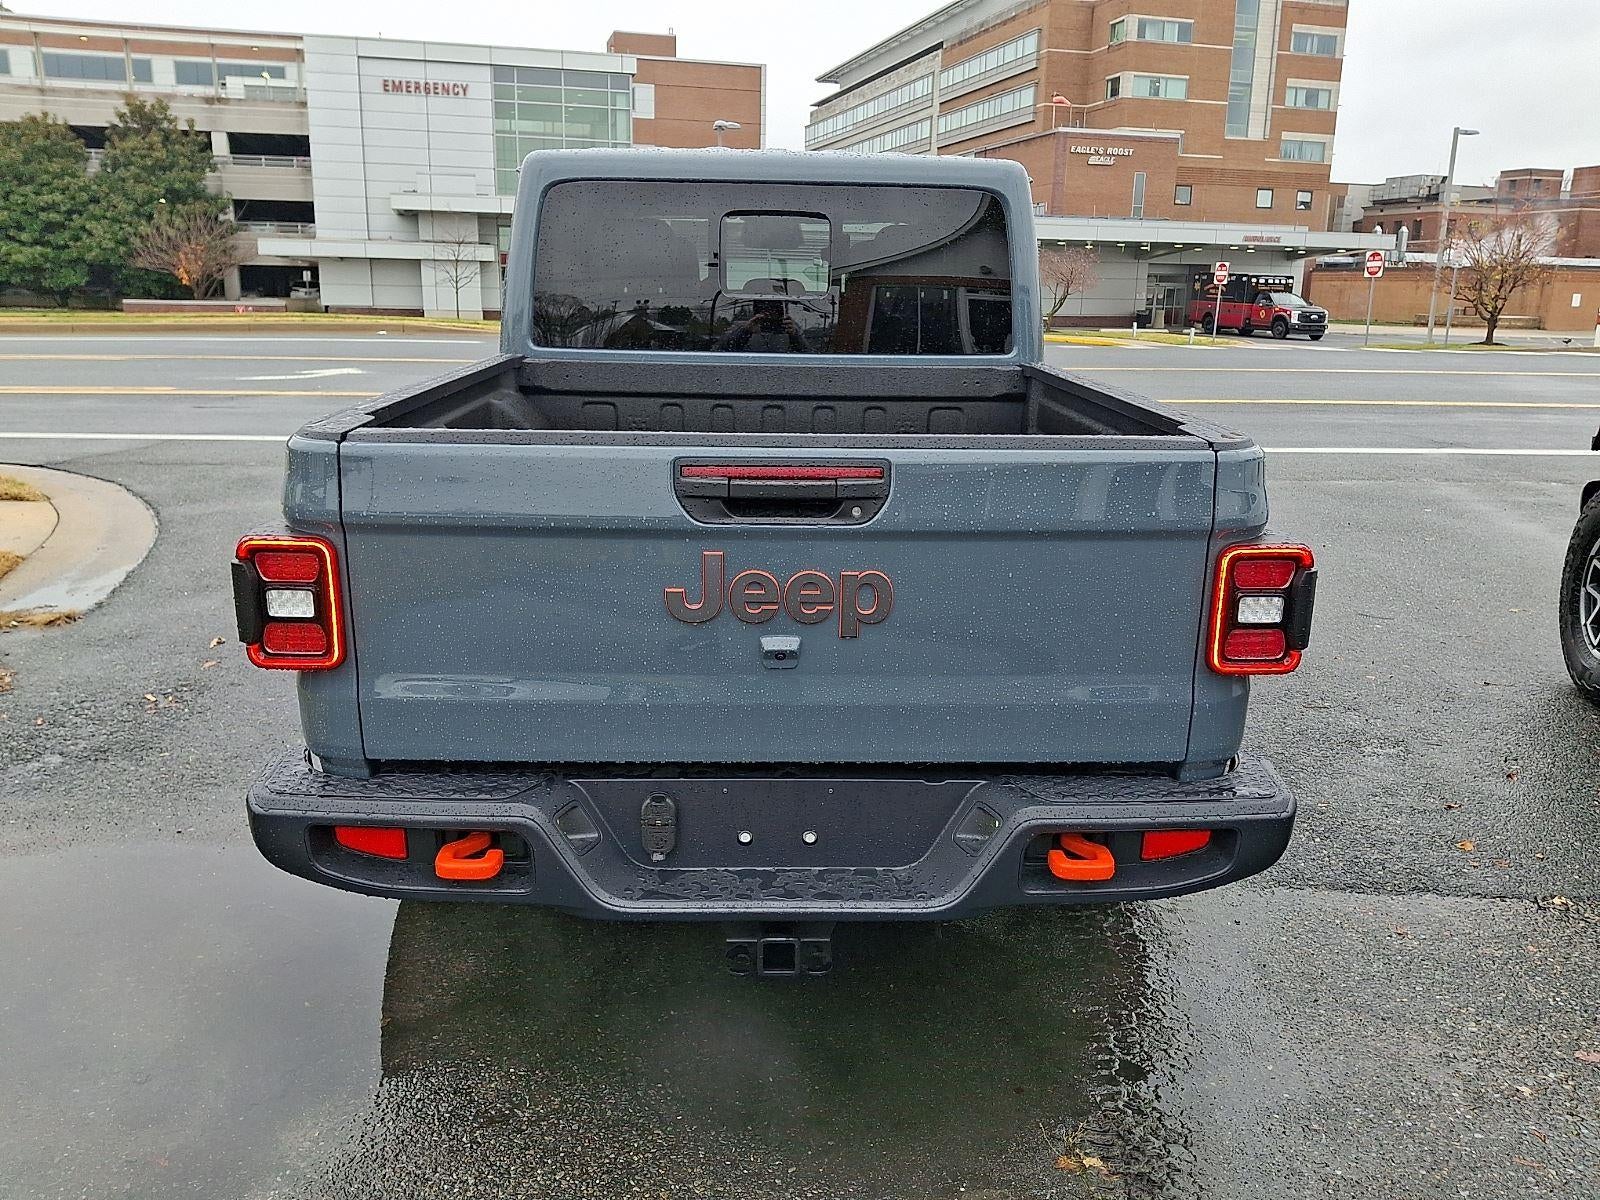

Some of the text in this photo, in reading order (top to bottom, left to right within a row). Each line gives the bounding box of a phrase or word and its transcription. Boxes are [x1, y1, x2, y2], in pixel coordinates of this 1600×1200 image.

[383, 79, 469, 96] EMERGENCY
[1070, 145, 1134, 156] EAGLE'S ROOST
[664, 551, 893, 638] Jeep
